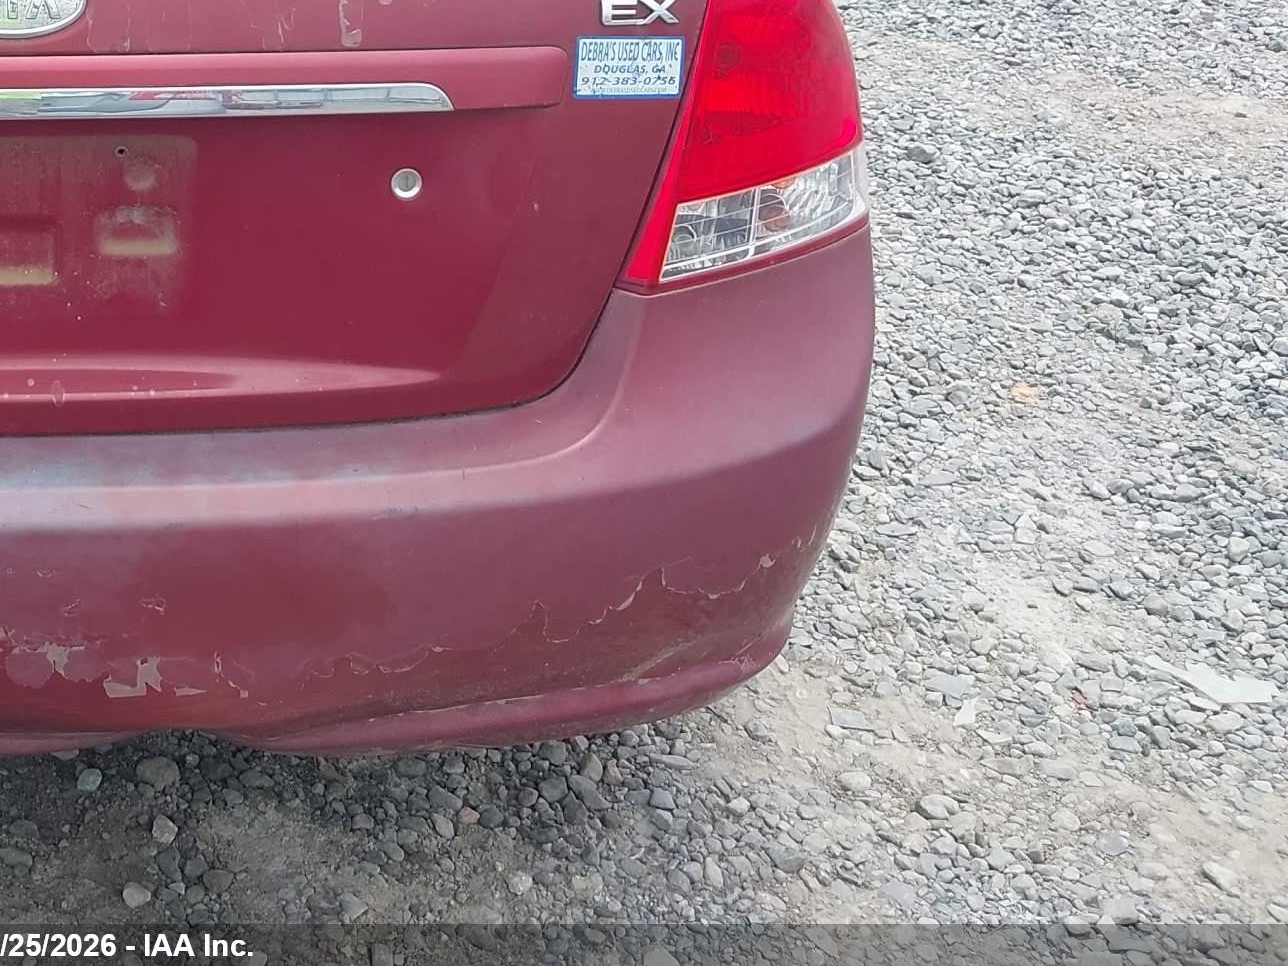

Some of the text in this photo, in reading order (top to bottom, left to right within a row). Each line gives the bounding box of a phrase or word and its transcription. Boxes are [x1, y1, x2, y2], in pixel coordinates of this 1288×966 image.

[580, 41, 616, 62] DEBRA'S
[617, 41, 640, 61] USED
[593, 64, 666, 74] DOUGLAS, GA
[581, 76, 676, 86] 912-383-0756
